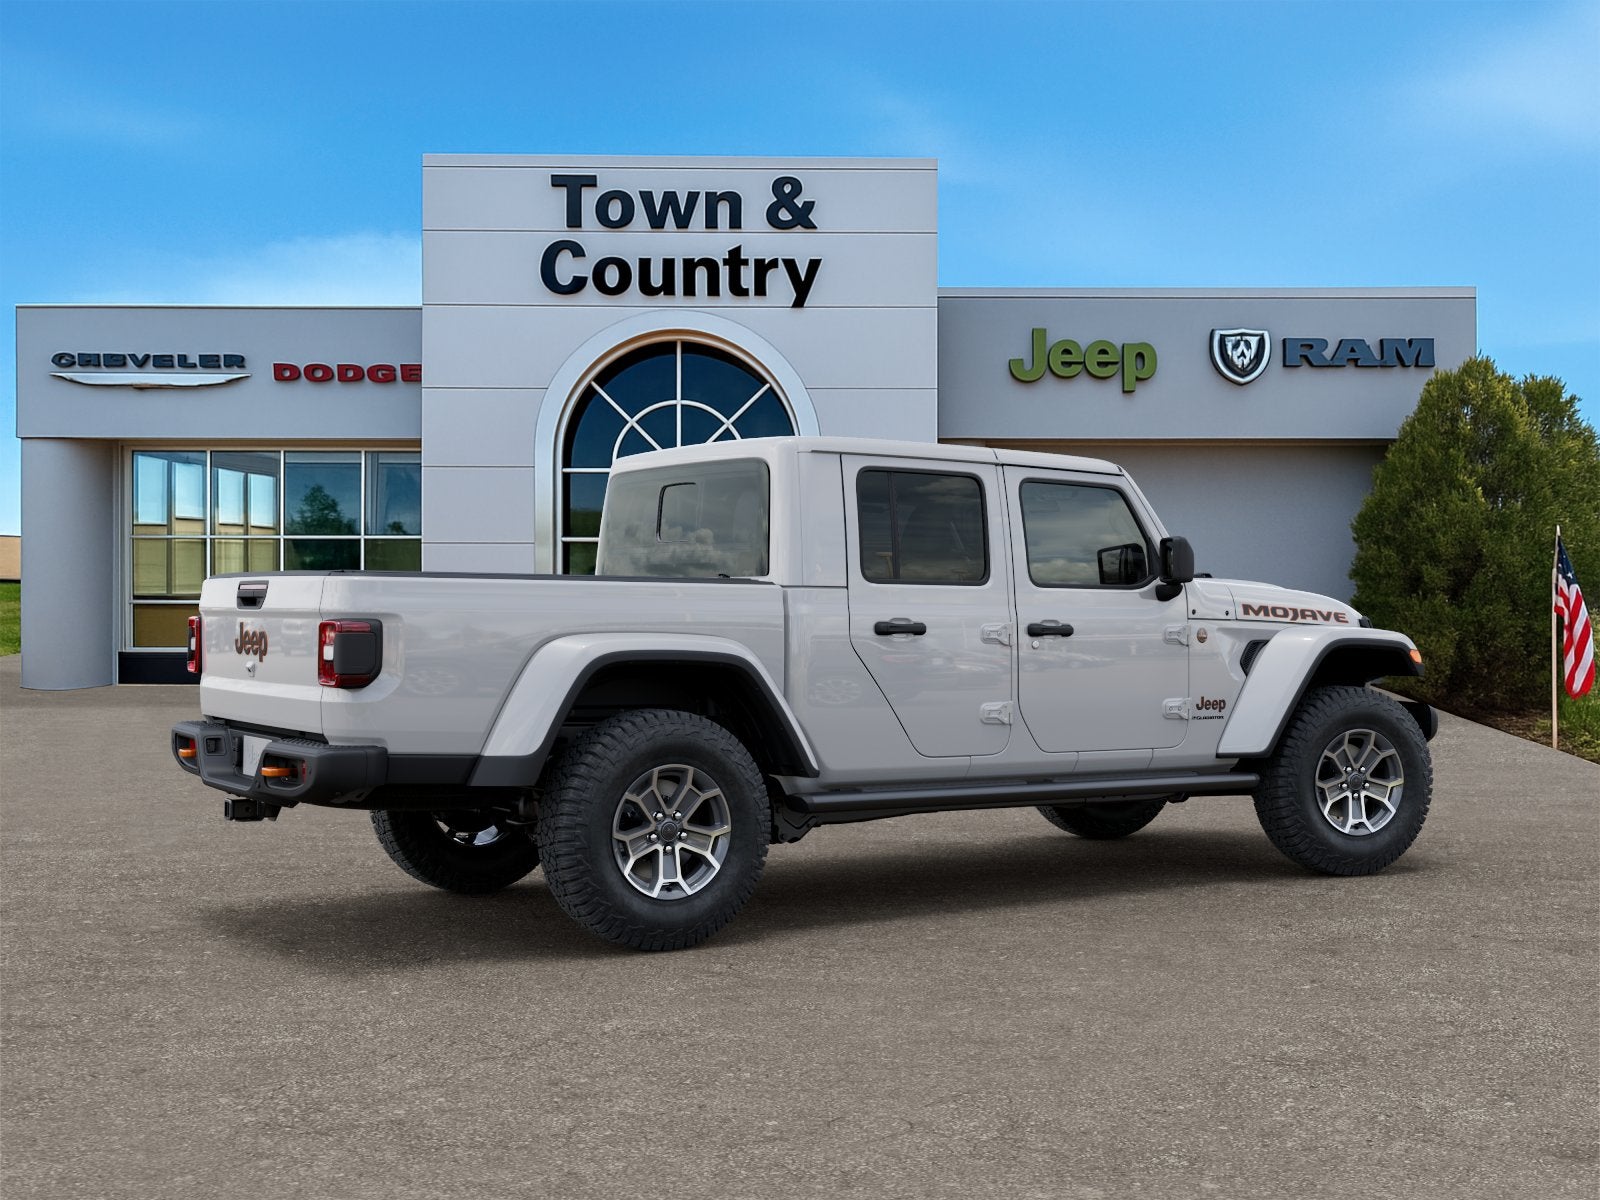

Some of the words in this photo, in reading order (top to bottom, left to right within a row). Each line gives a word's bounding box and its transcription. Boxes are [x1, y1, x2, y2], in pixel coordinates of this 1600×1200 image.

[551, 174, 742, 229] Town
[766, 176, 818, 229] &
[540, 239, 822, 308] Country
[1009, 328, 1157, 392] Jeep
[1283, 338, 1435, 367] RAM
[273, 363, 422, 383] DODGE
[1242, 603, 1349, 623] MOJAVE
[235, 621, 268, 663] Jeep
[1195, 695, 1227, 712] Jeep
